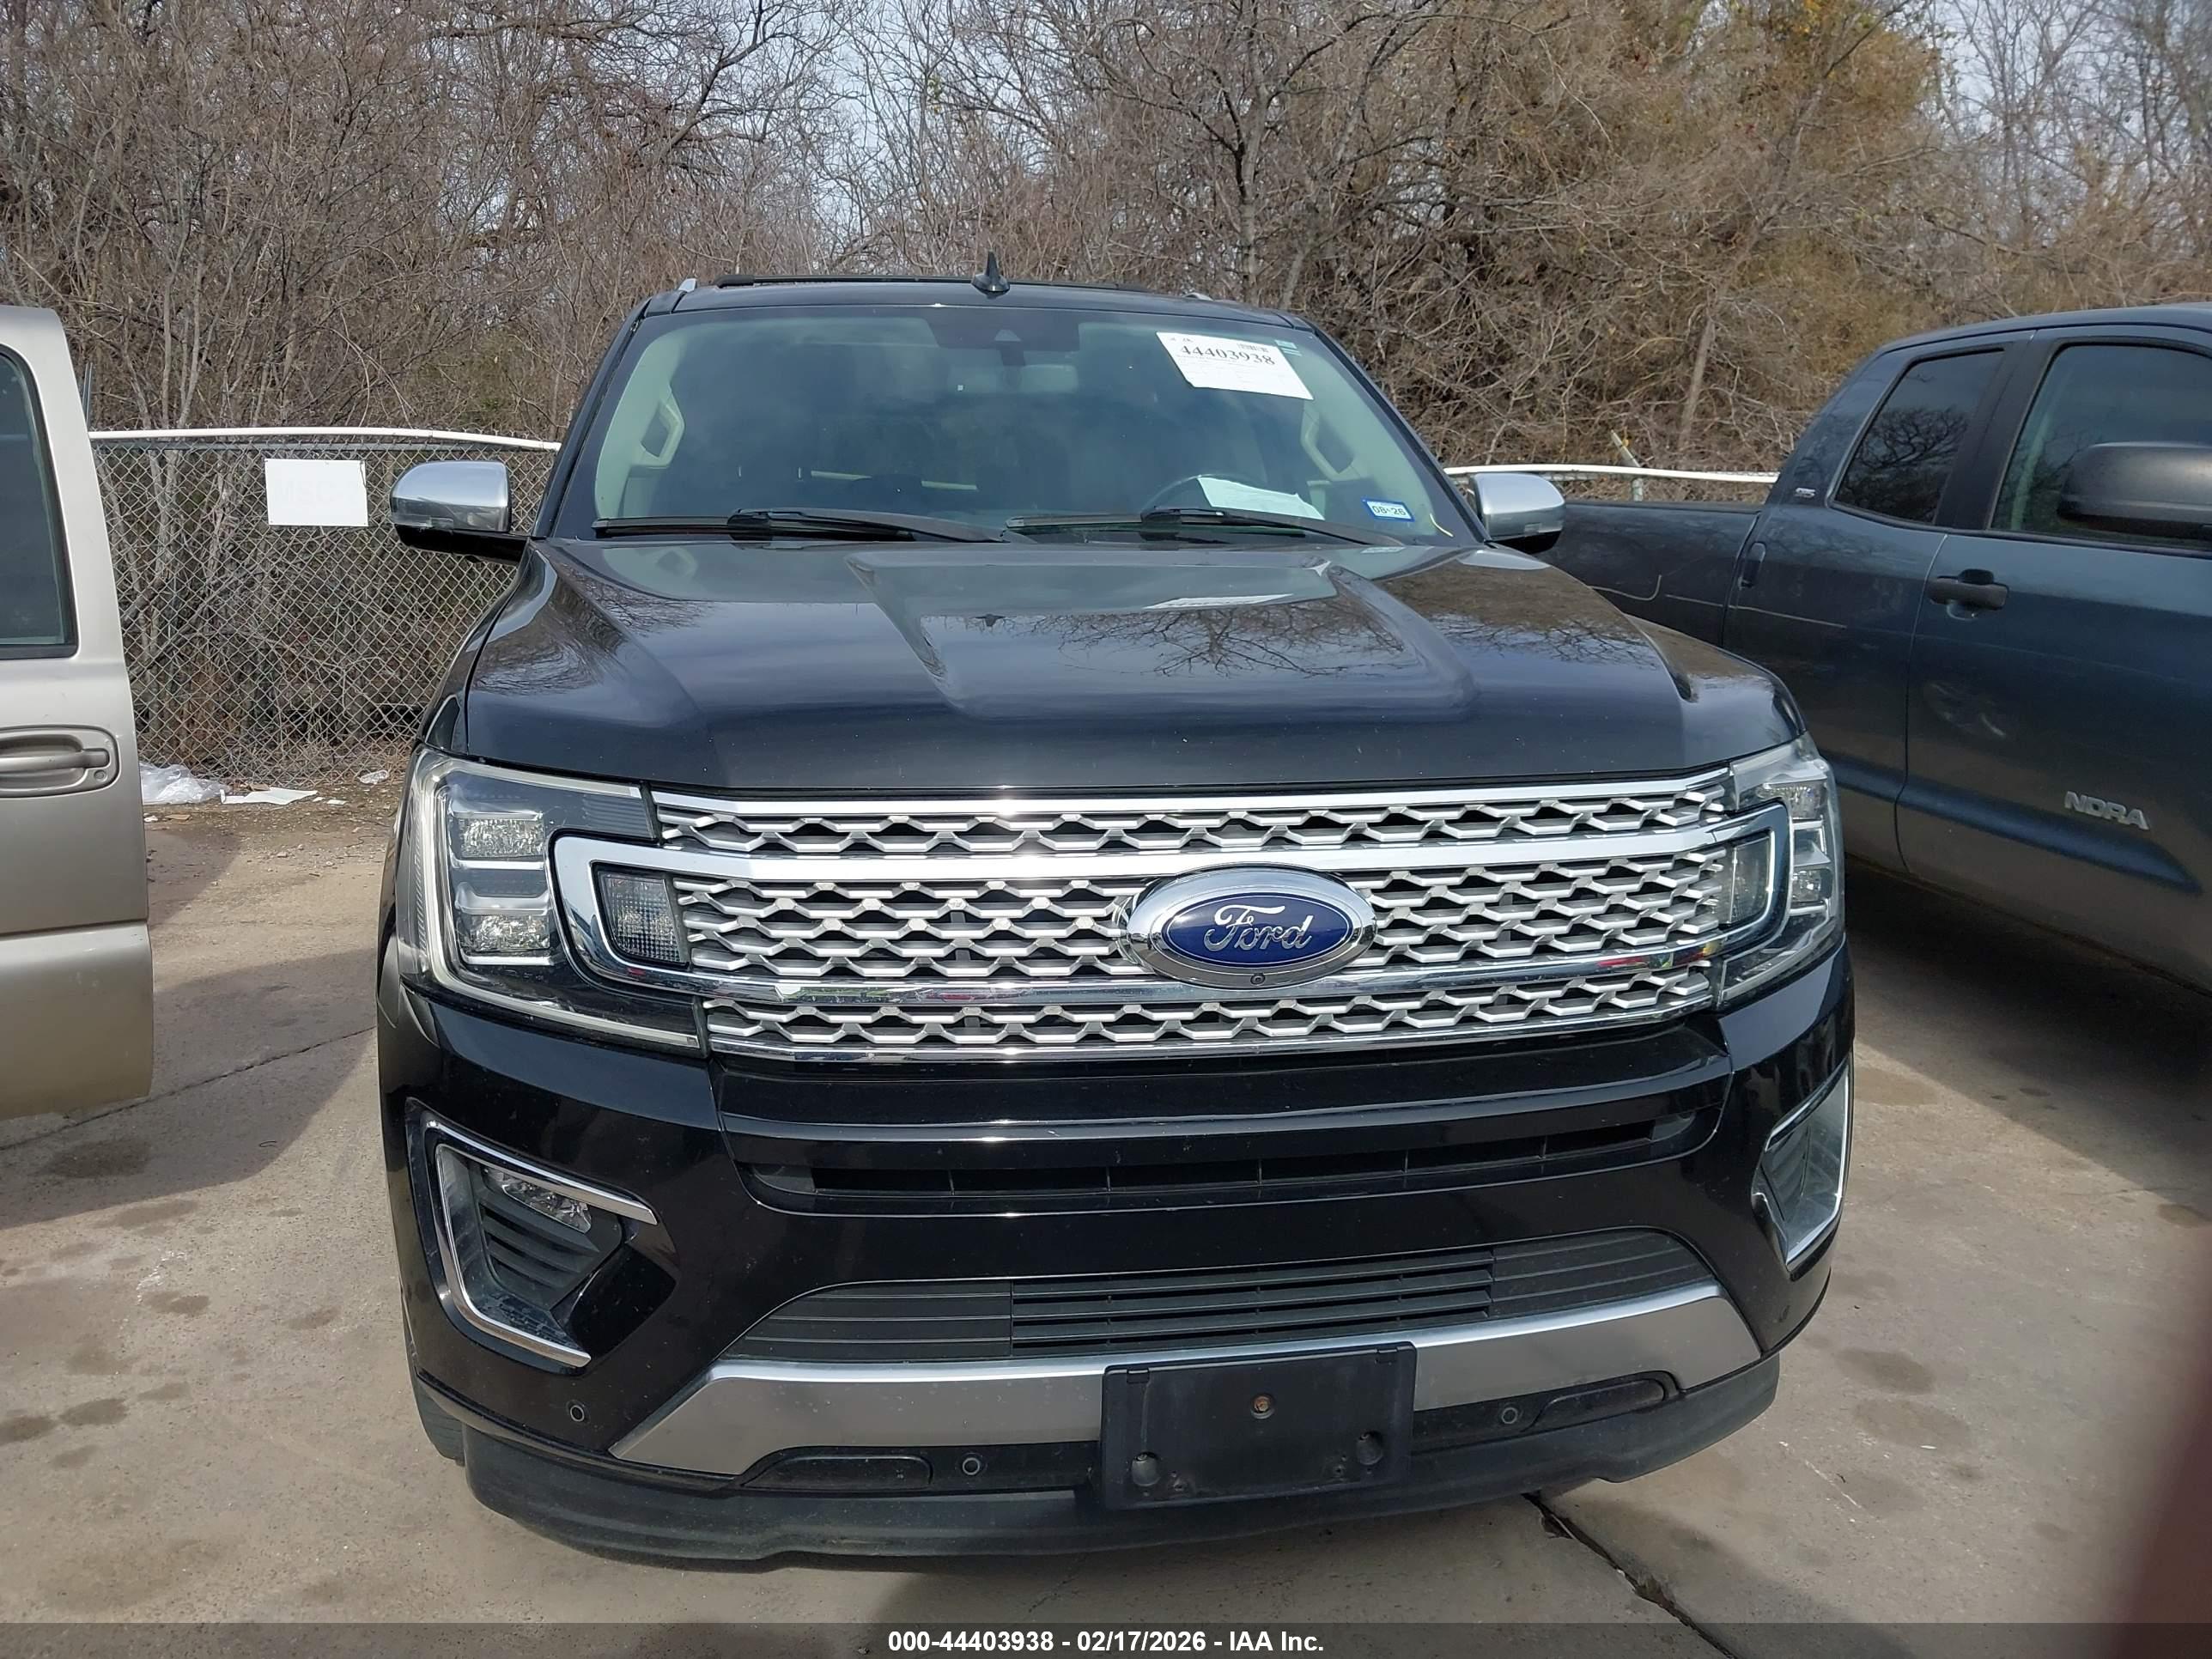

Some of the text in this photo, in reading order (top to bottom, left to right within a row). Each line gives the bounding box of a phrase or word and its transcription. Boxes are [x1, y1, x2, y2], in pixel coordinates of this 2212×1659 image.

[1181, 345, 1276, 365] 44403938
[2063, 790, 2149, 831] NDRA
[1204, 903, 1314, 951] Ford
